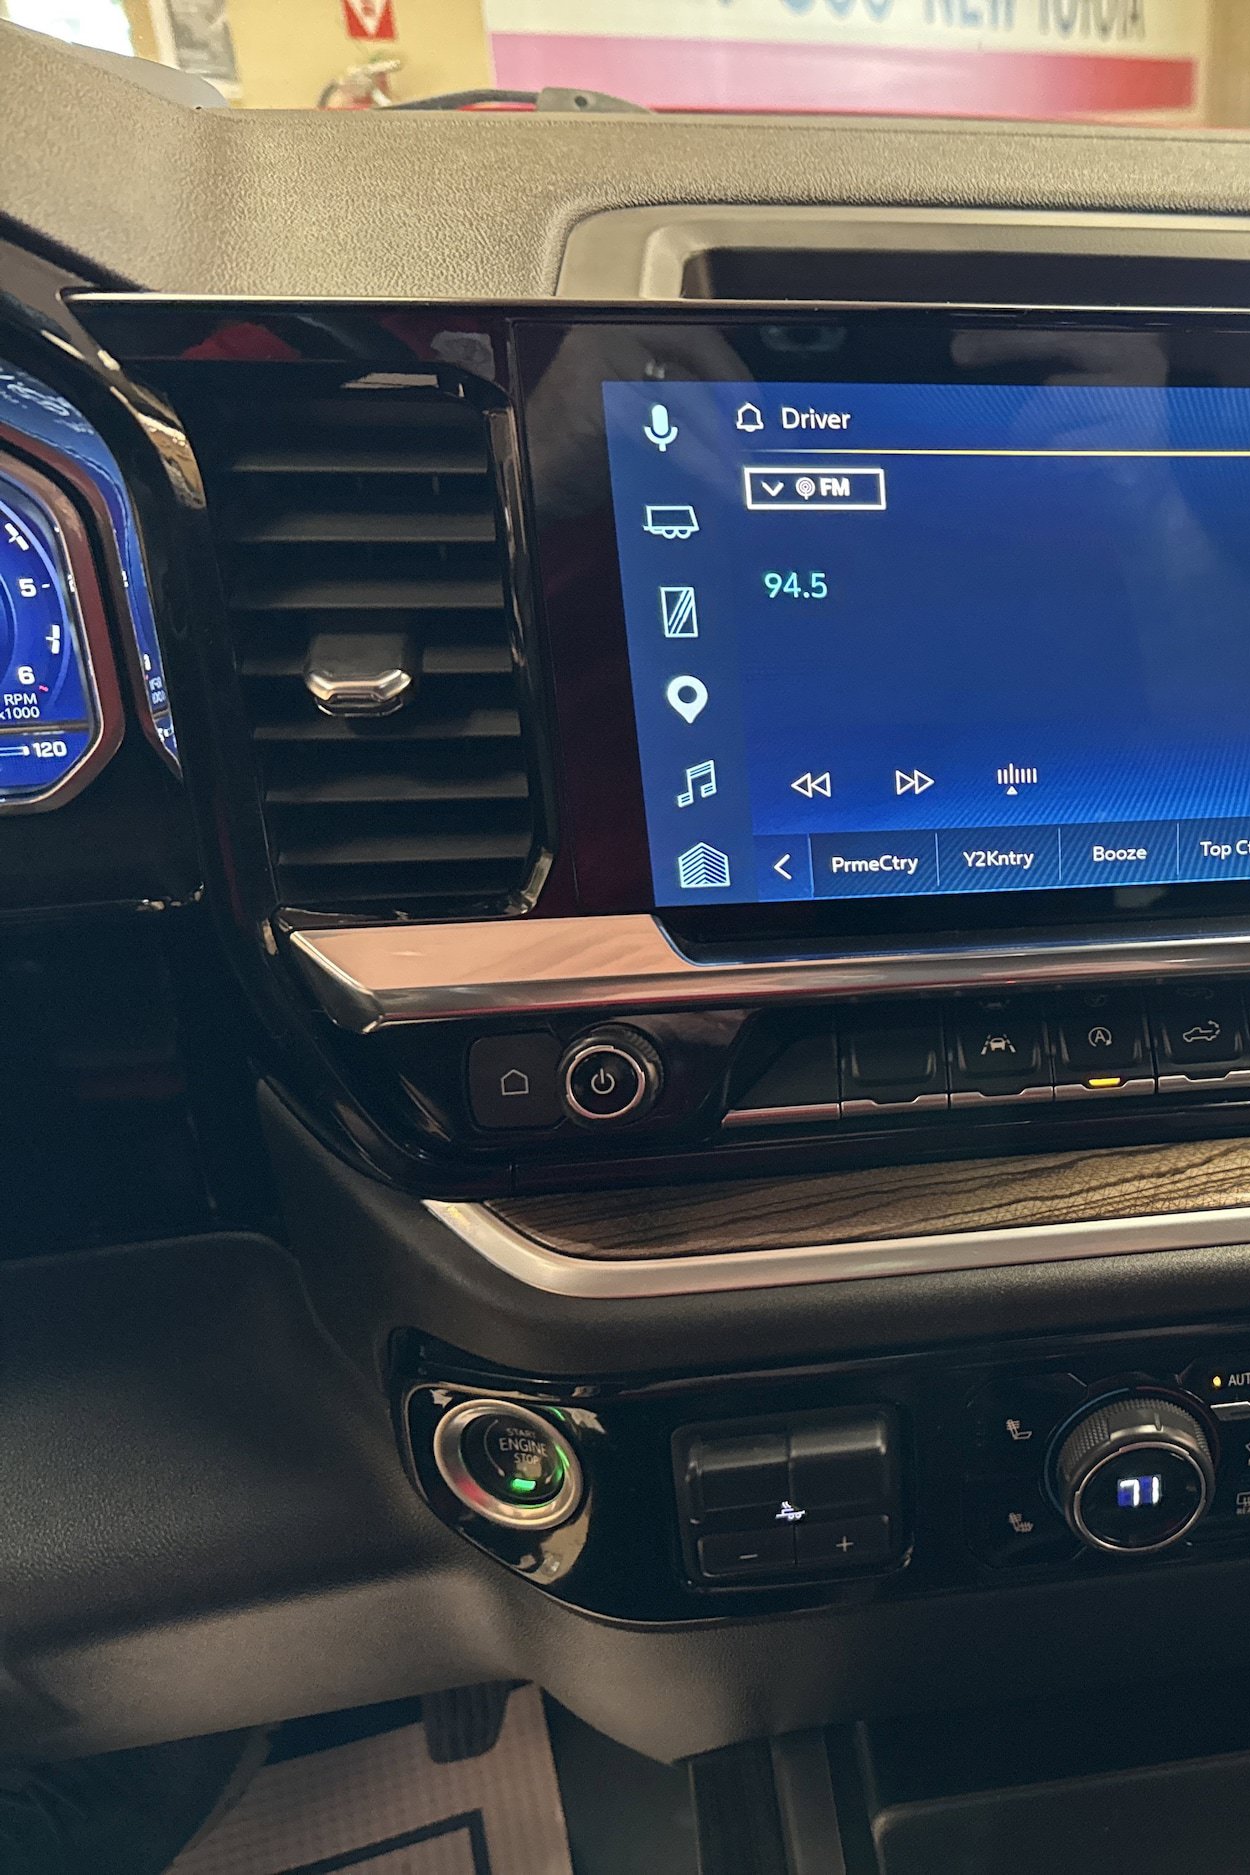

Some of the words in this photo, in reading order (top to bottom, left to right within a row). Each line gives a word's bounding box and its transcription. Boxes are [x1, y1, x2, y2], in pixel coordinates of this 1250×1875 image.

[782, 407, 851, 430] Driver
[820, 478, 850, 497] FM
[19, 578, 37, 598] 5
[765, 572, 828, 598] 94.5
[17, 666, 36, 685] 6
[3, 692, 38, 706] RPM
[32, 740, 68, 758] 120
[1093, 844, 1147, 862] Booze
[1200, 841, 1231, 859] Top
[832, 855, 918, 875] PrmeCtry
[964, 851, 1034, 869] Y2Kntry
[506, 1428, 536, 1439] START
[499, 1438, 548, 1458] ENGINE
[514, 1453, 539, 1465] STOP
[1118, 1476, 1160, 1508] 71
